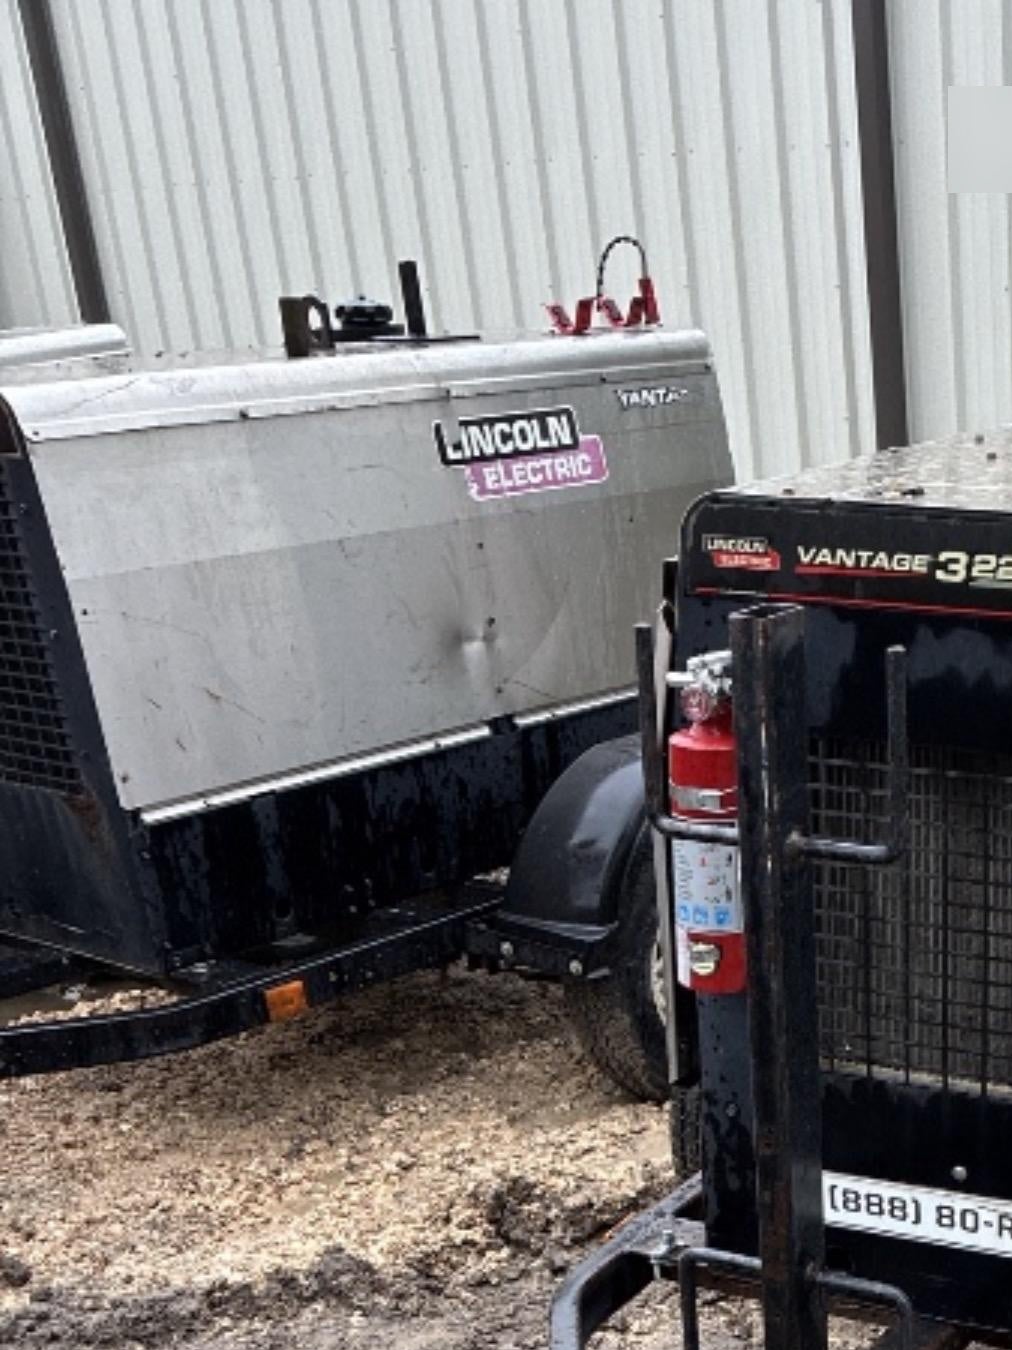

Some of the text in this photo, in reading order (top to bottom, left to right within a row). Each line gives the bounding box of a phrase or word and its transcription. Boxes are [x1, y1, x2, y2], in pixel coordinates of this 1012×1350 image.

[444, 413, 575, 460] LINCOLN
[482, 453, 593, 490] ELECTRIC
[797, 545, 931, 574] VANTAGE
[828, 1183, 922, 1225] (888)
